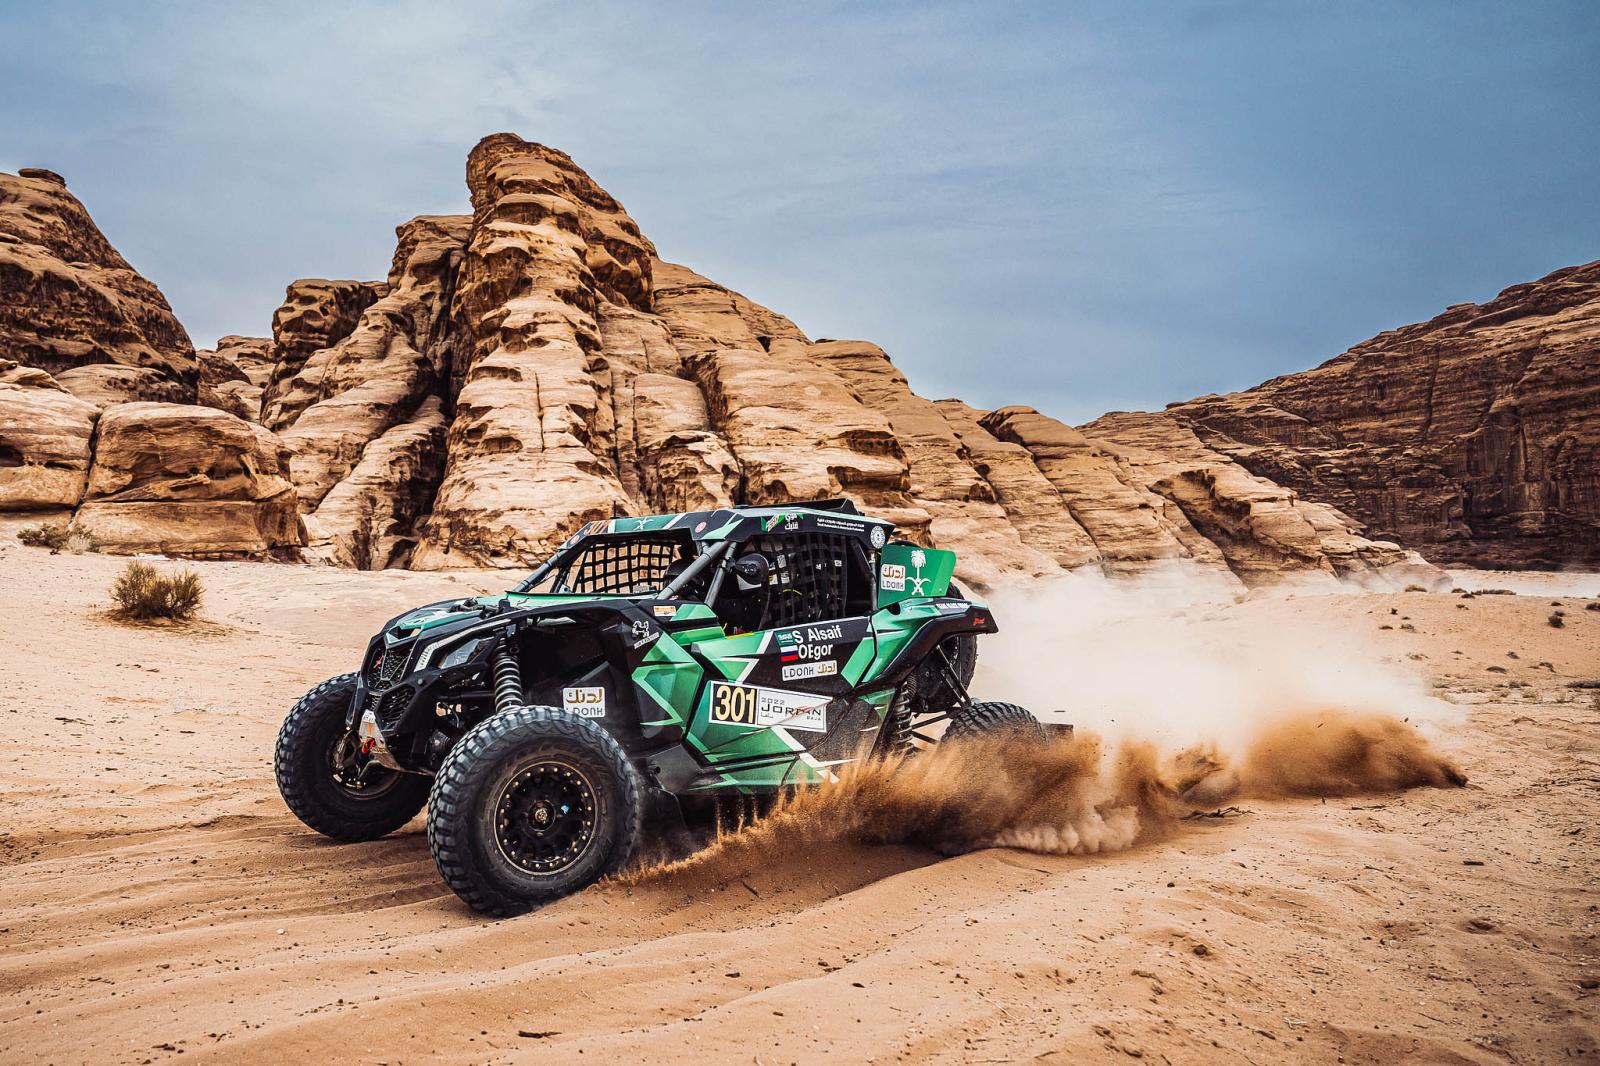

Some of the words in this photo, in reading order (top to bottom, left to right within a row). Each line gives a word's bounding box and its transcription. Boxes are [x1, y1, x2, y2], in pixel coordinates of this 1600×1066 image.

[792, 630, 804, 644] S
[807, 624, 843, 642] Alsaif
[715, 685, 756, 724] 301
[761, 697, 785, 705] 2022
